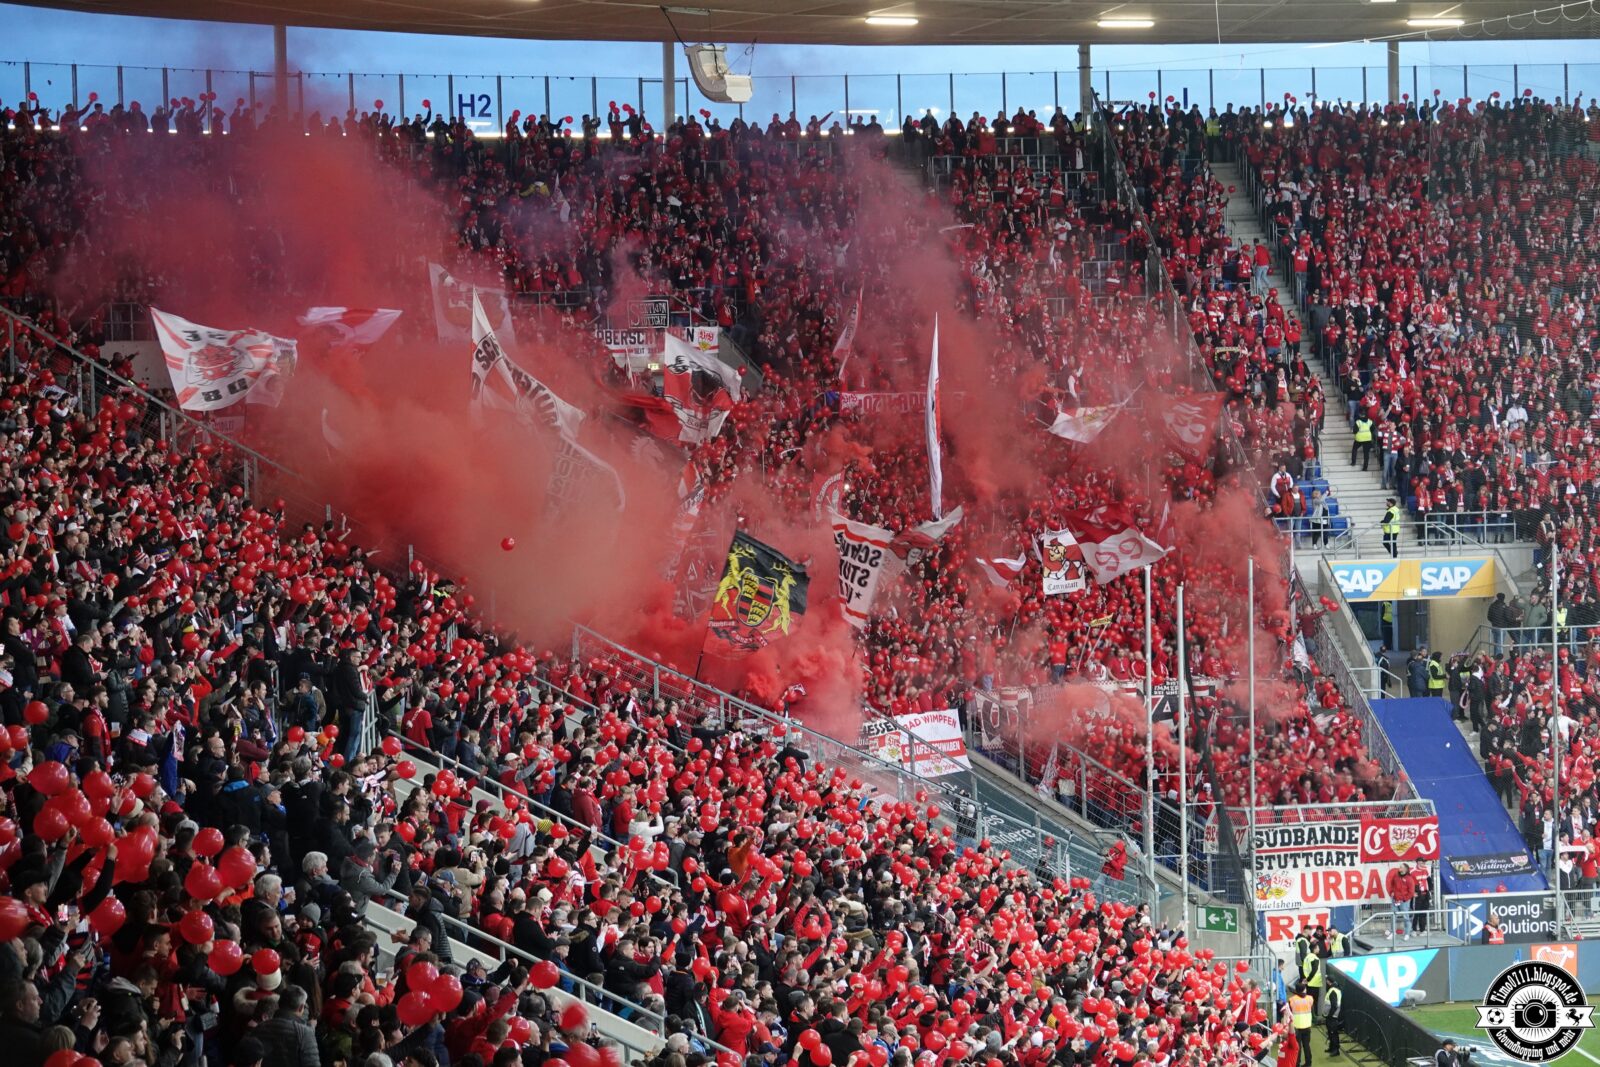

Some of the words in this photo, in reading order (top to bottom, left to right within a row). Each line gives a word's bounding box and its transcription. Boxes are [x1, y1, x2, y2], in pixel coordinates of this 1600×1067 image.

[458, 93, 492, 118] H2
[596, 328, 695, 346] OBERSCHEN
[1334, 569, 1384, 593] SAP
[1421, 566, 1472, 590] SAP
[922, 714, 957, 729] WIMPFEN
[1255, 825, 1359, 849] SÜDBANDE
[1255, 851, 1358, 871] STUTTGART
[1499, 918, 1557, 935] olutions
